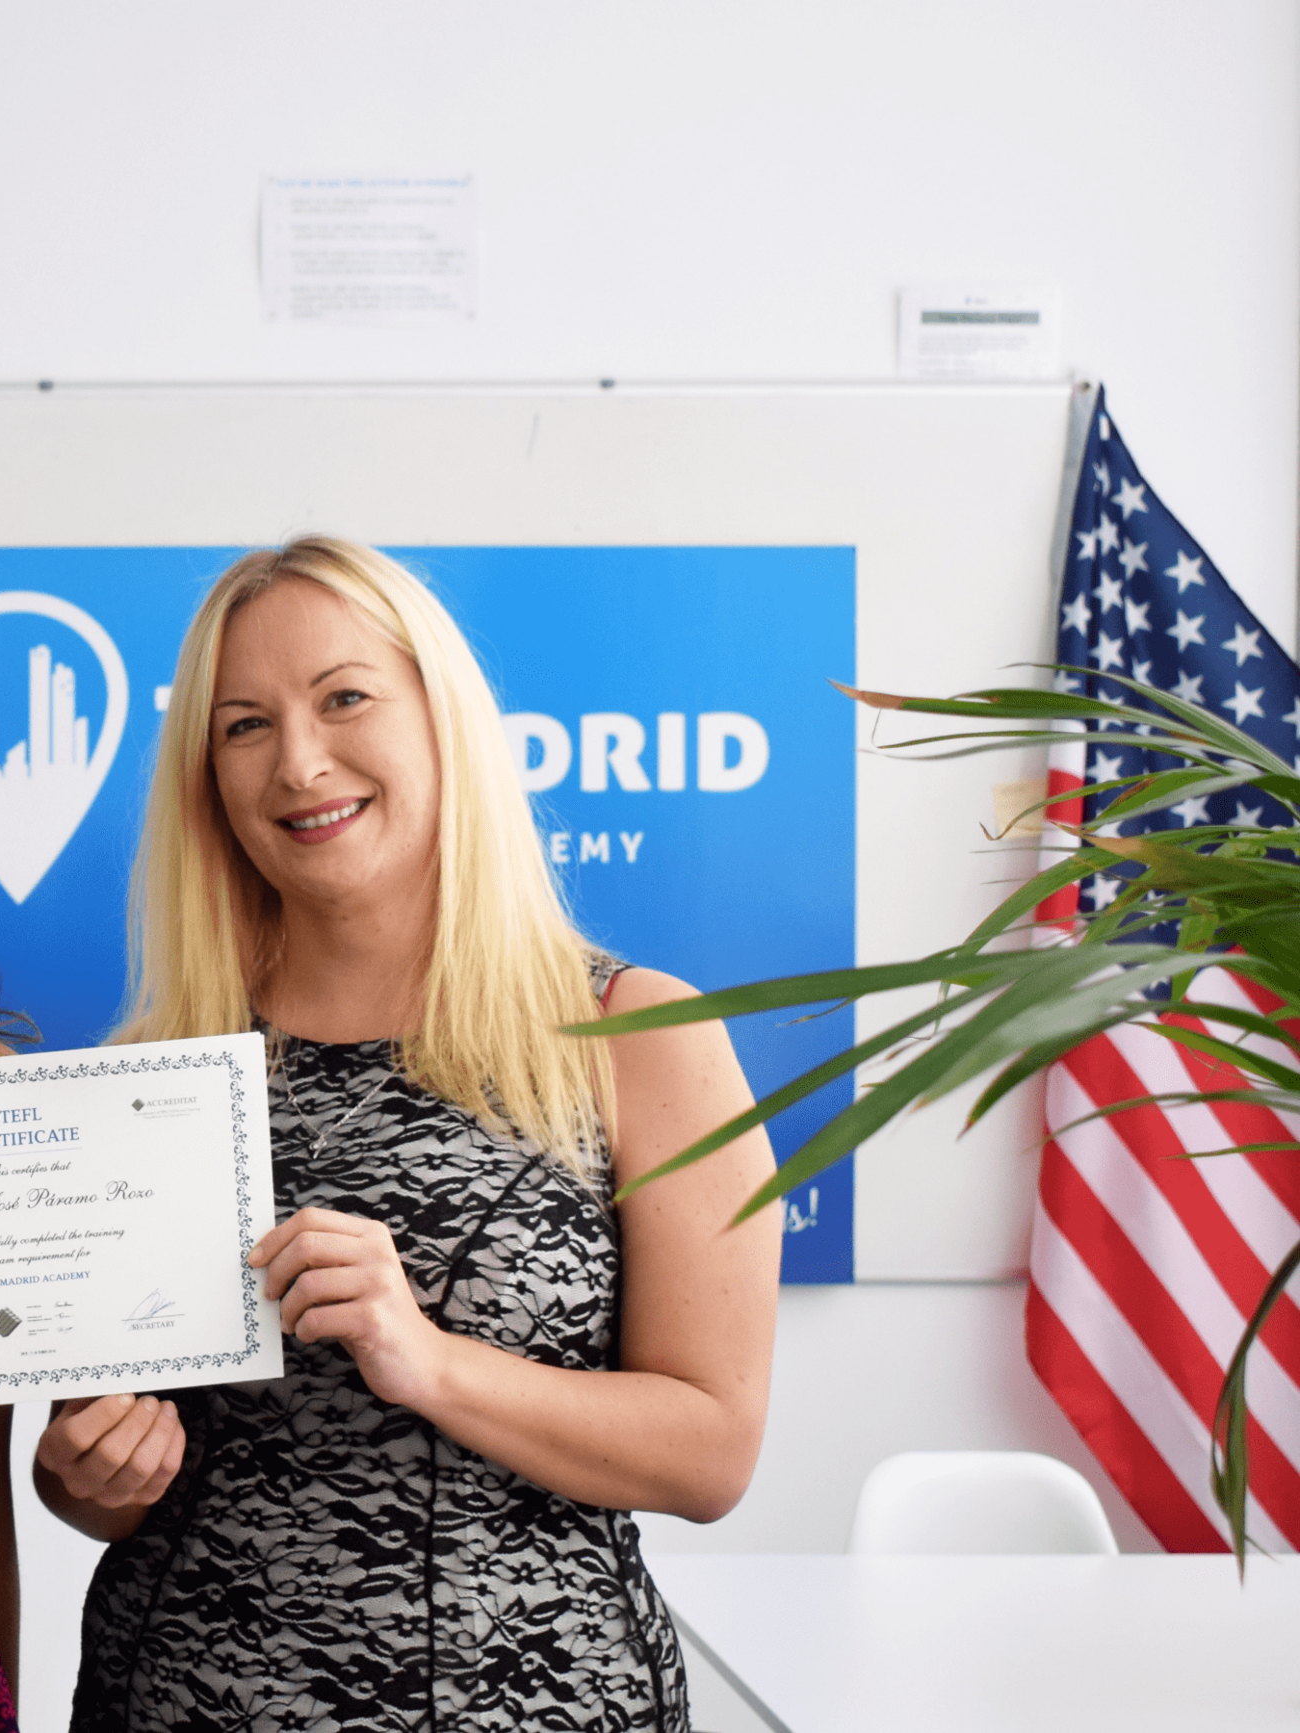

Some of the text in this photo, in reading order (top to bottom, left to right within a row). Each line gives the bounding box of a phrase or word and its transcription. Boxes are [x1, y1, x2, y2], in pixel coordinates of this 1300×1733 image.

[500, 711, 769, 793] DRID
[0, 1107, 43, 1124] TEFL
[11, 1161, 48, 1178] certifies
[50, 1160, 72, 1172] that
[26, 1187, 99, 1209] Páramo
[105, 1180, 155, 1202] Rozo
[19, 1231, 67, 1247] completed
[68, 1228, 84, 1240] the
[84, 1226, 126, 1241] training
[17, 1251, 75, 1266] requirement
[75, 1247, 91, 1262] for
[0, 1275, 41, 1287] MADRID
[42, 1270, 91, 1283] ACADEMY
[131, 1321, 175, 1331] SECRETARY
